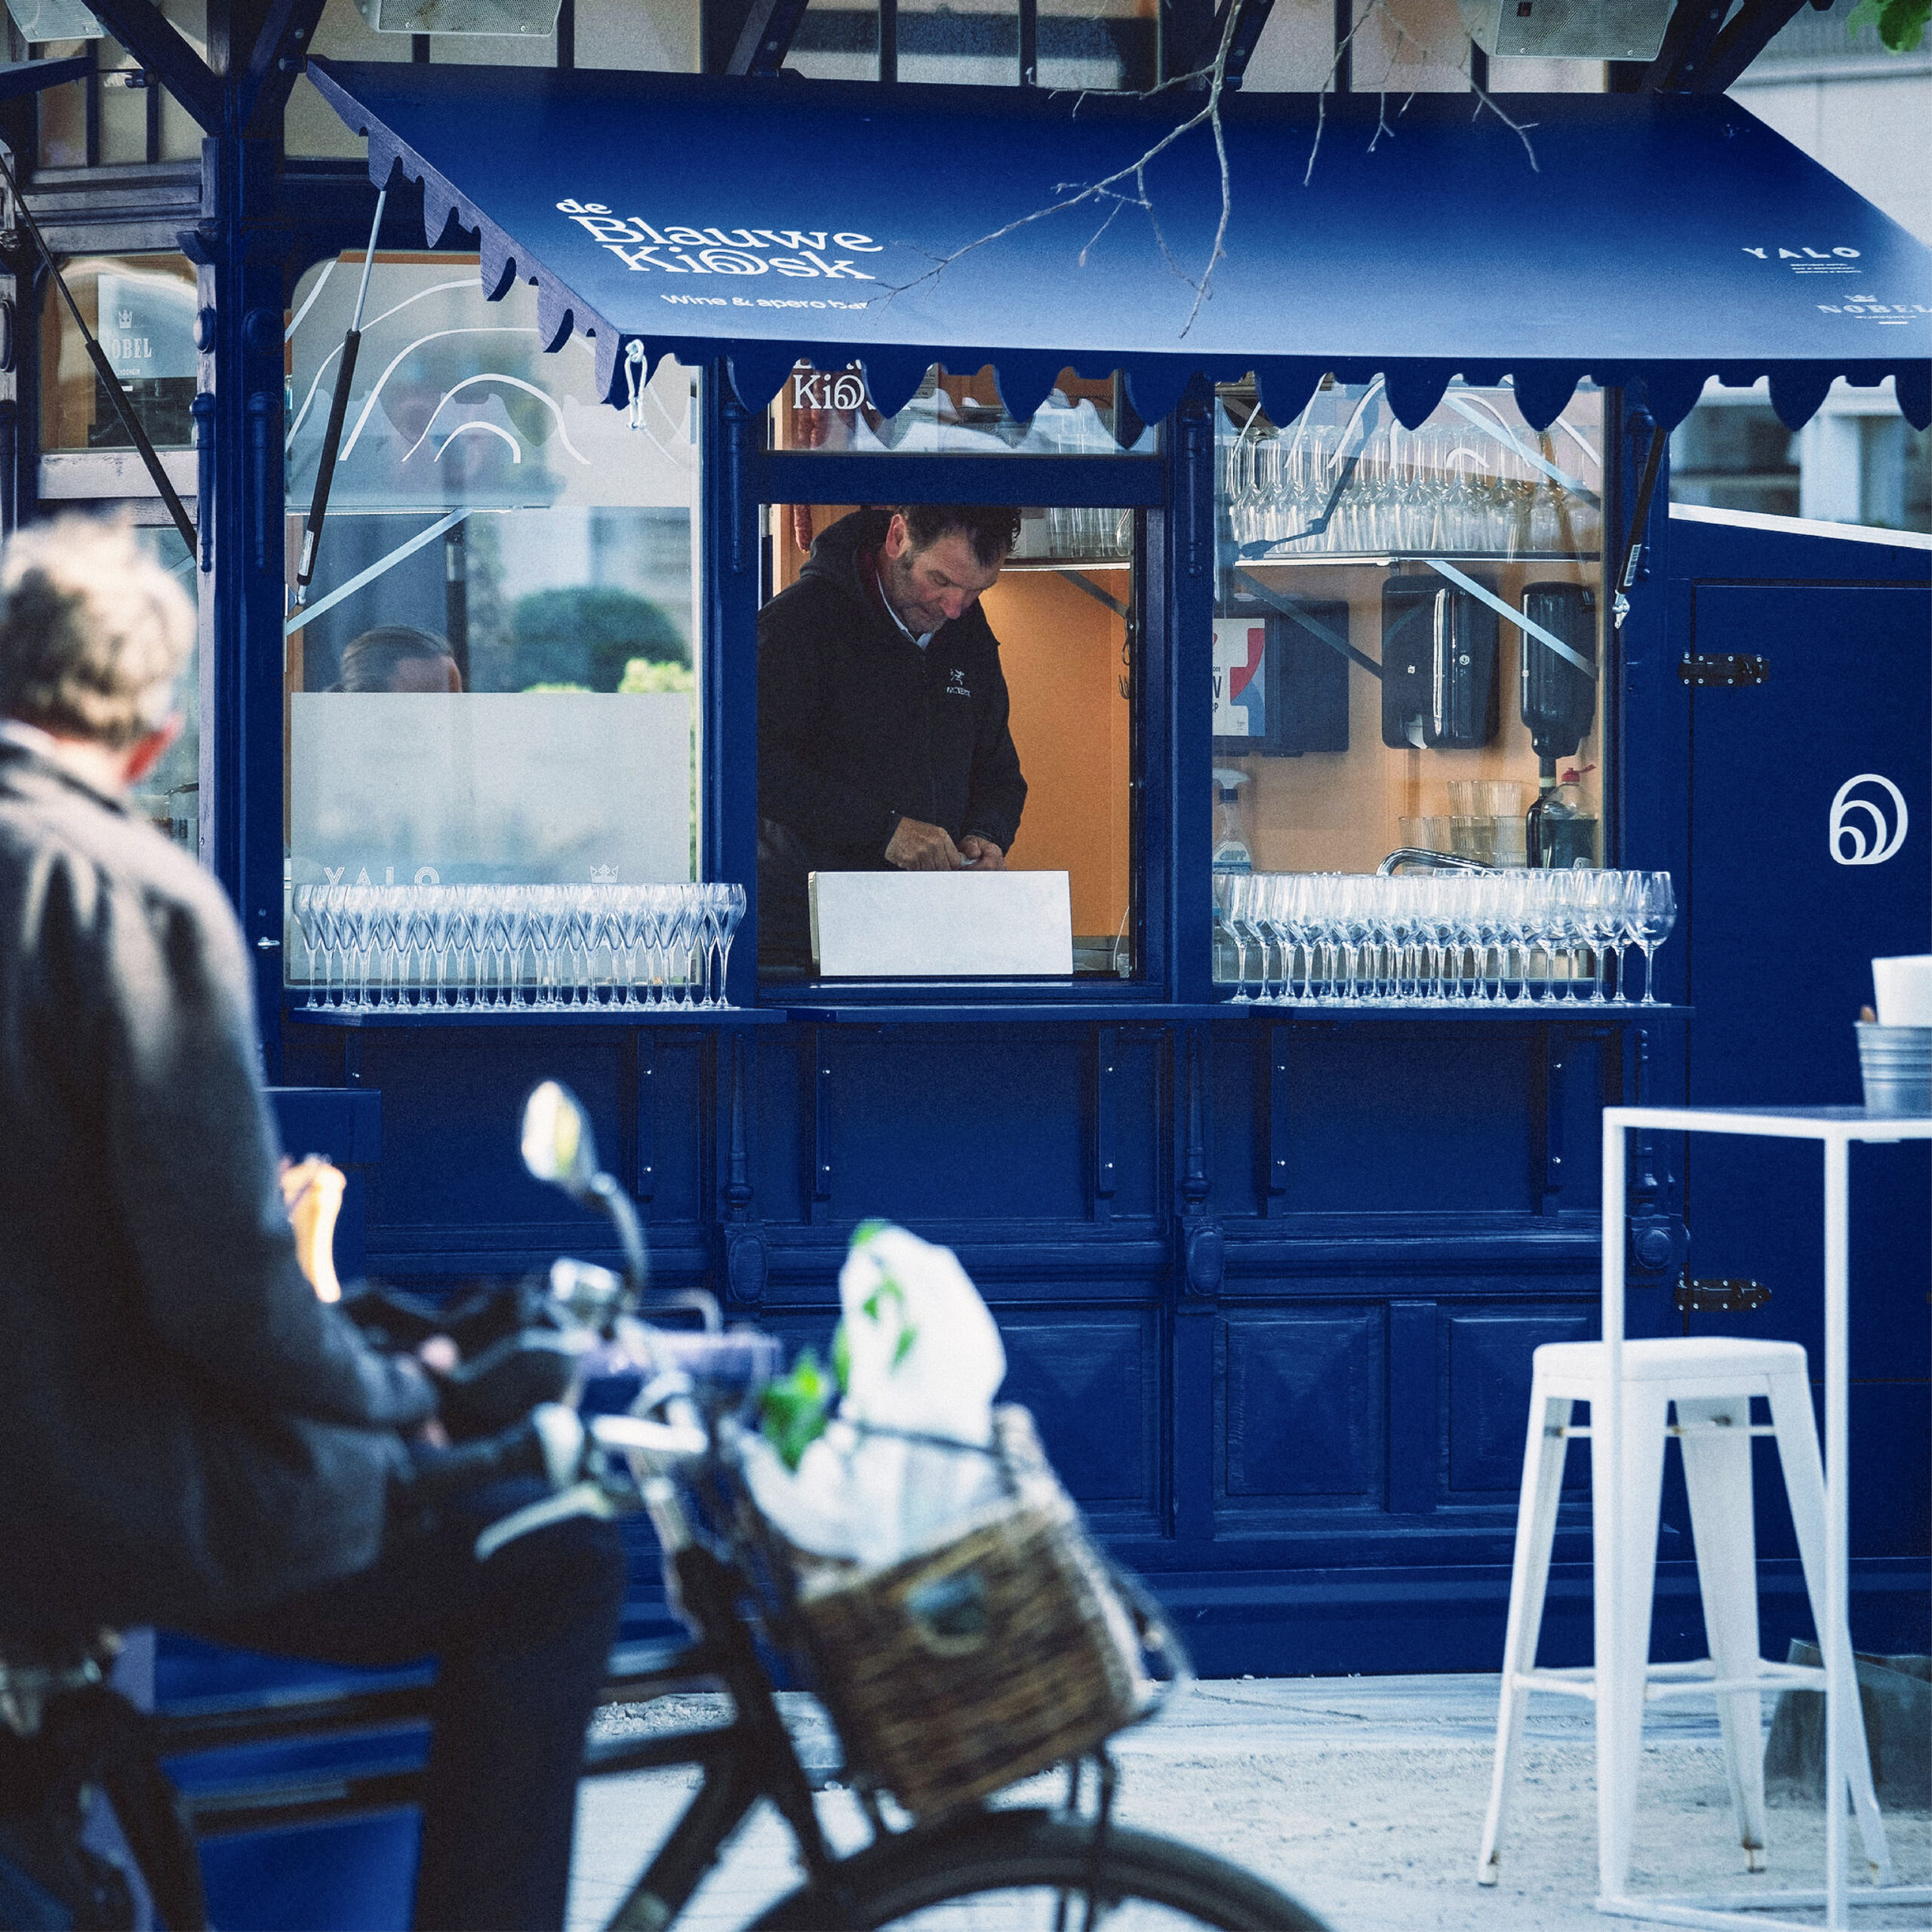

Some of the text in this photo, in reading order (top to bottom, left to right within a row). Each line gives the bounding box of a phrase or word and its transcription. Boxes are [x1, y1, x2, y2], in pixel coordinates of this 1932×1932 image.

[555, 198, 612, 214] de
[569, 216, 883, 252] Blauwe
[602, 245, 876, 279] Kiosk
[1741, 247, 1861, 259] YALO
[660, 294, 727, 306] Wine
[731, 297, 754, 306] &
[756, 298, 826, 309] apero
[1815, 304, 1932, 314] NOBEL
[110, 337, 152, 359] OBEL
[792, 374, 911, 411] Kio
